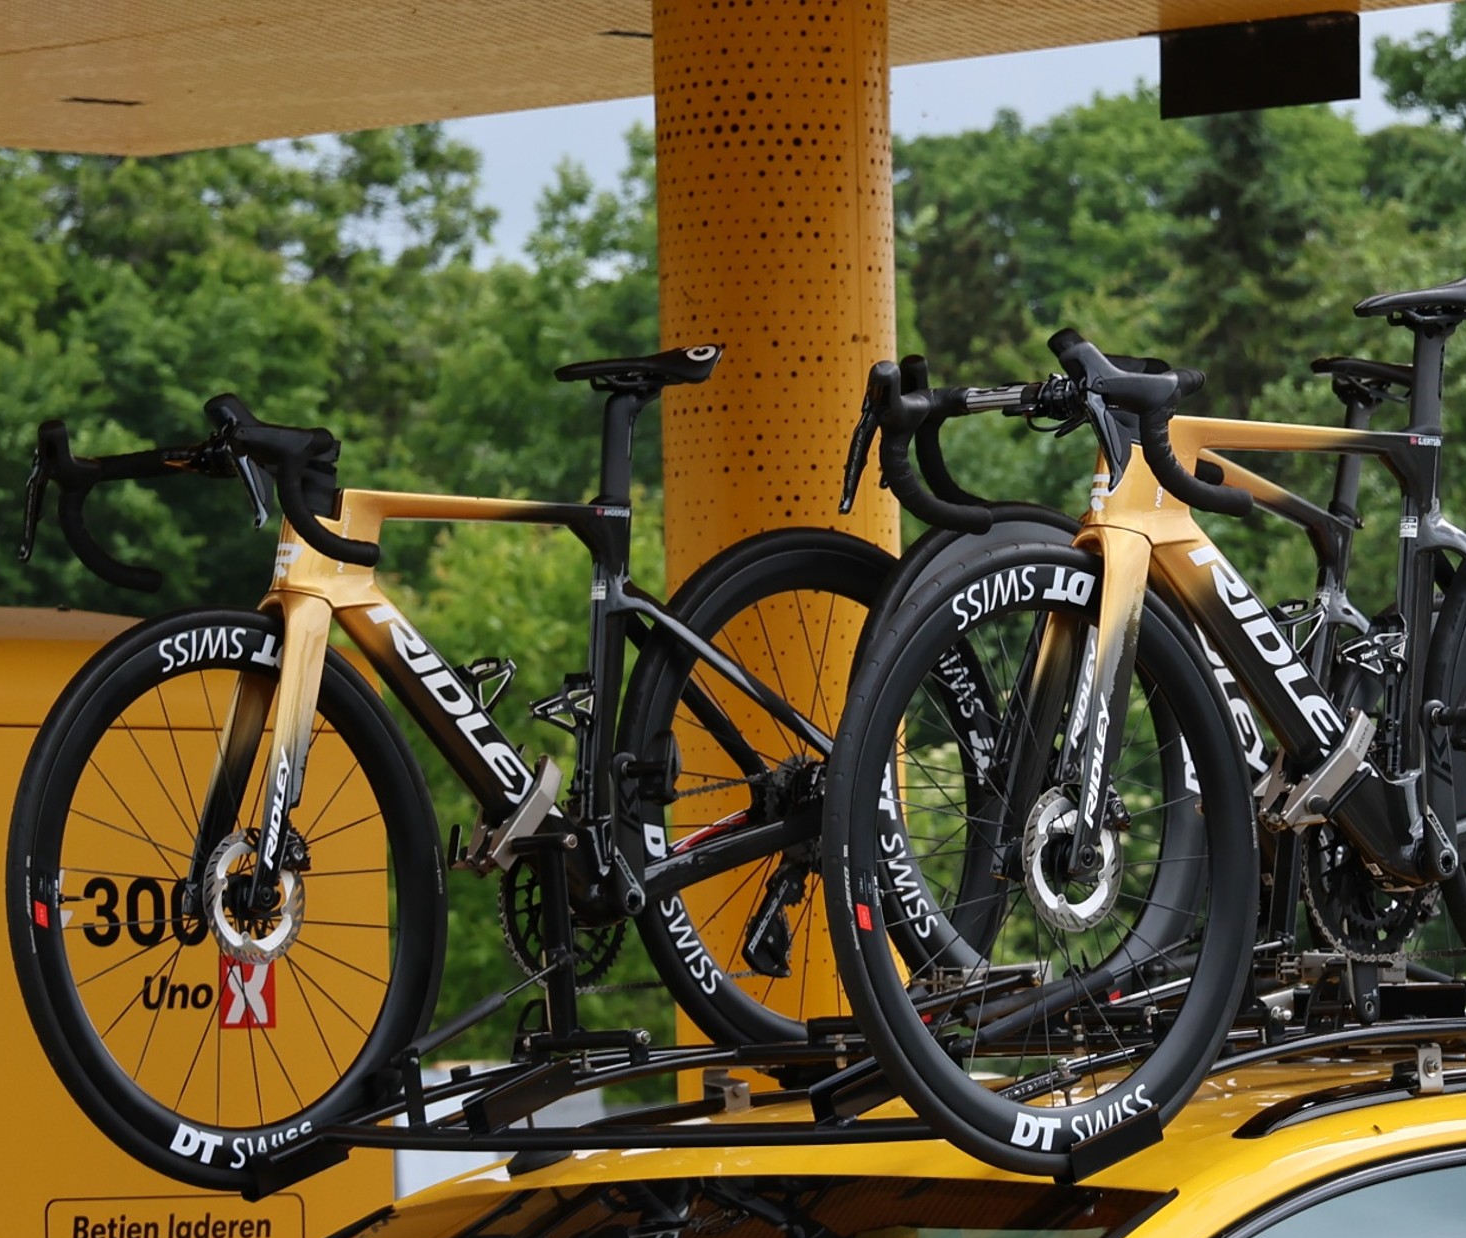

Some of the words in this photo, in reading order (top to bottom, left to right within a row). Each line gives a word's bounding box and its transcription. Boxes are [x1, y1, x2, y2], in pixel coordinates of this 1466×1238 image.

[951, 566, 1036, 631] SWISS
[1043, 566, 1097, 606] DT
[158, 627, 247, 673] SWISS
[251, 633, 283, 670] T
[1084, 691, 1111, 829] RIDLEY
[263, 745, 290, 870] RIDLEY
[880, 832, 939, 939] SWISS
[660, 897, 724, 996] SWISS
[141, 975, 215, 1010] Uno
[169, 1122, 224, 1165] DT
[1009, 1111, 1062, 1151] DT
